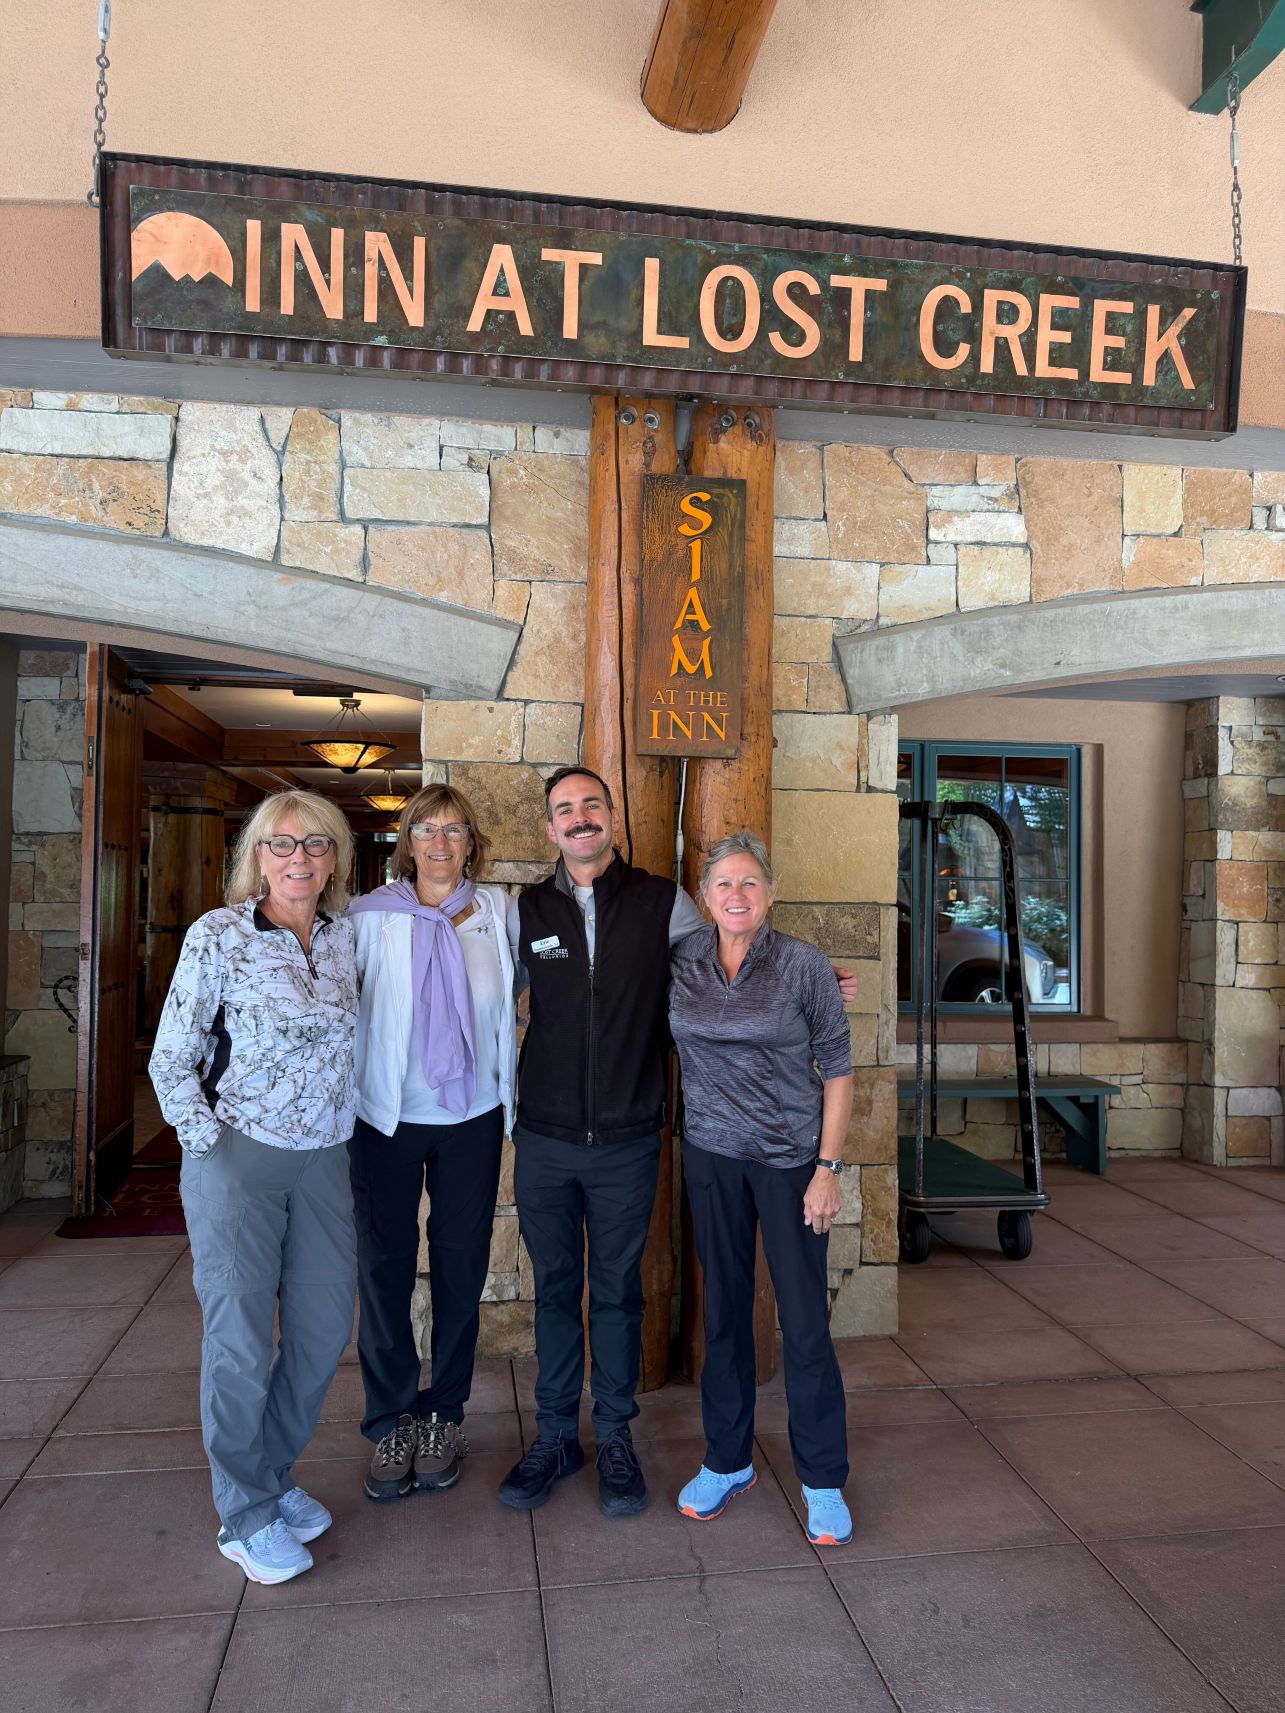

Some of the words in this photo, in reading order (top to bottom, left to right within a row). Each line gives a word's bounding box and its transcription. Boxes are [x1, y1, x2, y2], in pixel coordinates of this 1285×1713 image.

[245, 219, 426, 327] INN
[466, 243, 603, 339] AT
[642, 257, 888, 361] LOST
[919, 284, 1196, 390] CREEK
[670, 492, 713, 680] SIAM
[649, 709, 729, 741] INN
[652, 688, 679, 705] AT
[686, 690, 728, 707] THE
